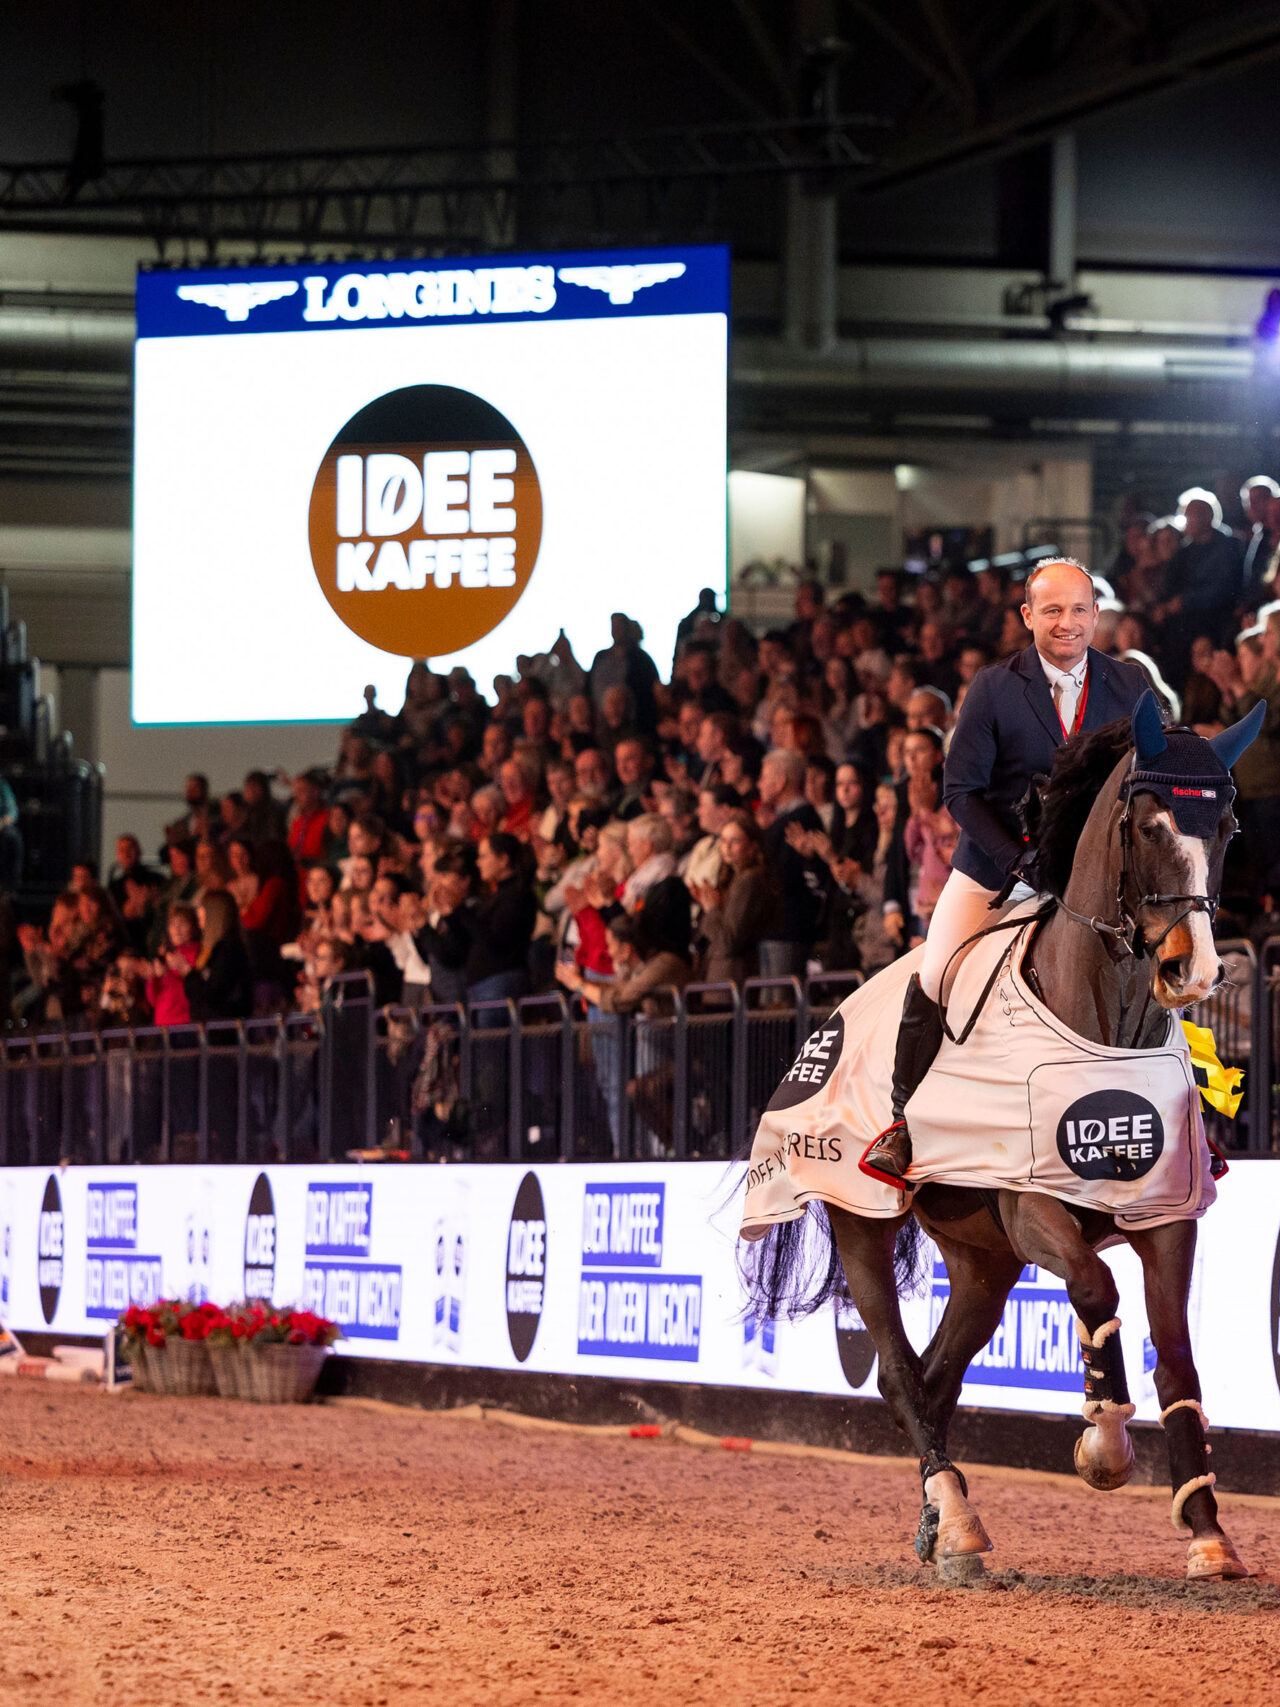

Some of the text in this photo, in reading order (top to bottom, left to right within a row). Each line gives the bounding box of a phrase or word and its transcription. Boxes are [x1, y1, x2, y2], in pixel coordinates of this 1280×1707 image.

[303, 265, 557, 322] LONGINES
[336, 449, 517, 538] IDEE
[336, 538, 517, 592] KAFFEE
[1172, 787, 1202, 797] fischer
[796, 1030, 839, 1062] EE
[782, 1062, 826, 1084] FEE
[1066, 1113, 1153, 1146] IDEE
[787, 1132, 842, 1163] REIS
[1069, 1143, 1153, 1164] KAFFEE
